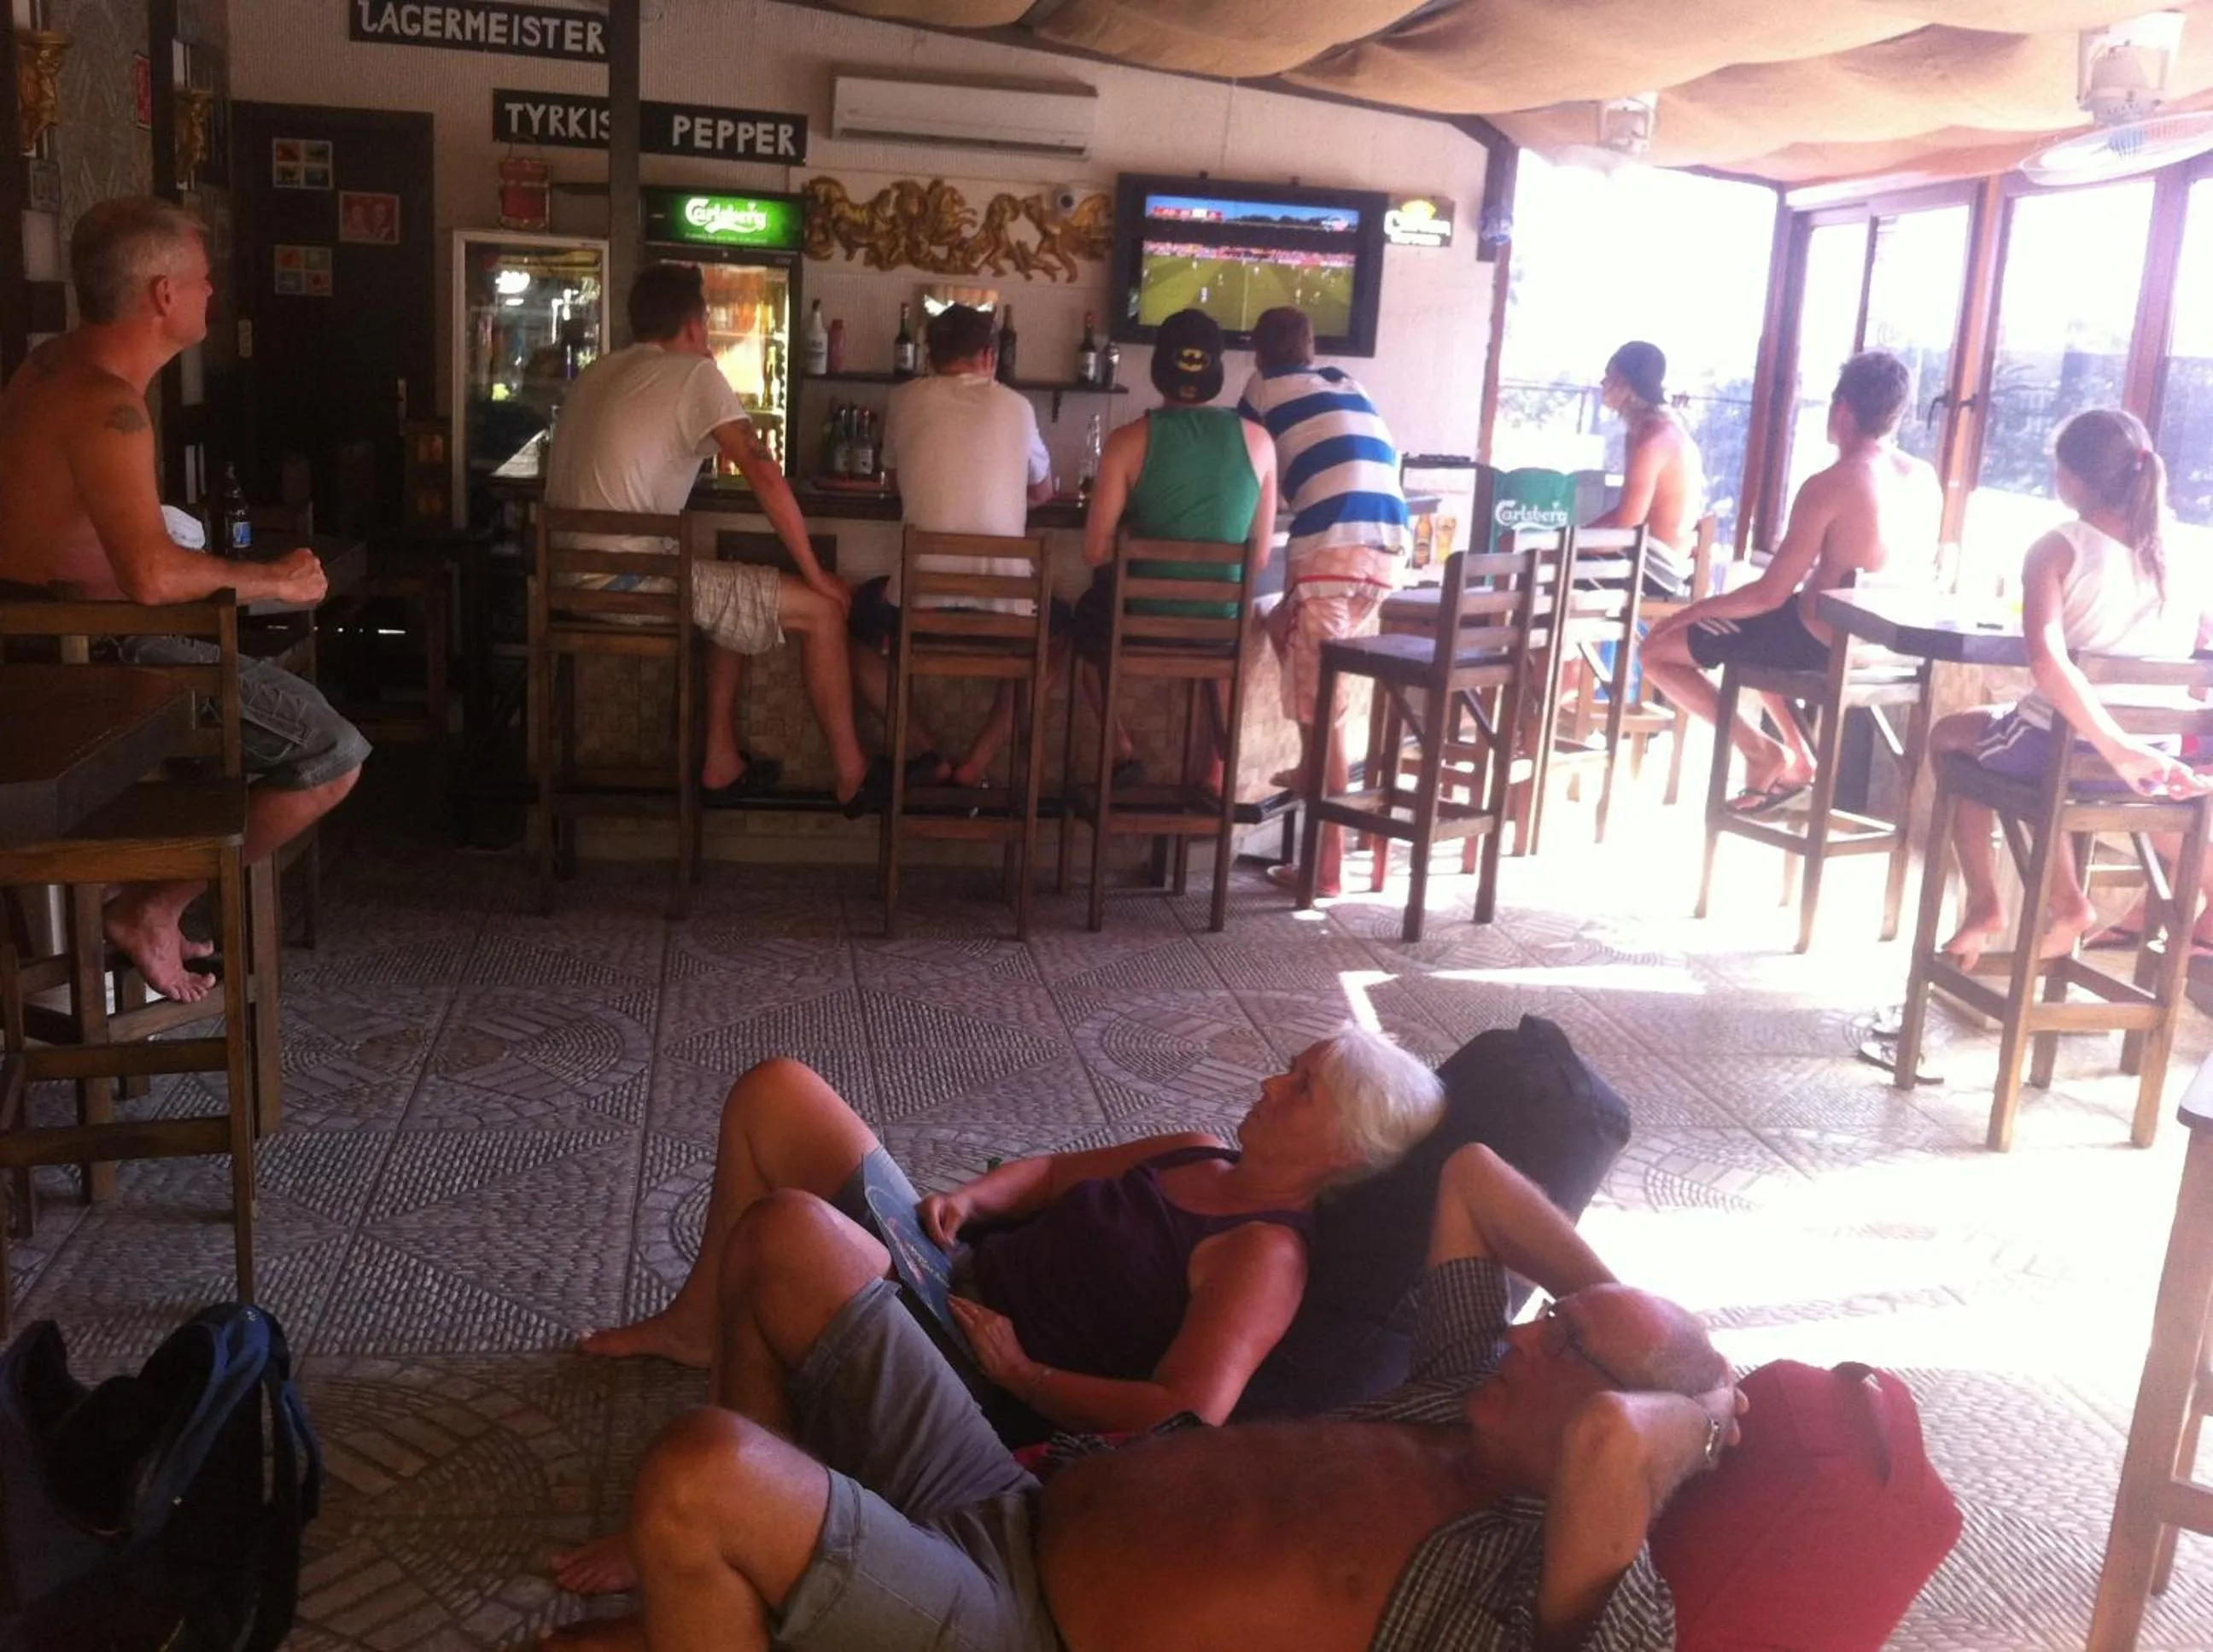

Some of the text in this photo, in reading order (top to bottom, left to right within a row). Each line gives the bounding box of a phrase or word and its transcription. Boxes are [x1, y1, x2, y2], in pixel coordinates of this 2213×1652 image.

[504, 102, 796, 157] TYRKIS PEPPER
[1495, 499, 1568, 530] Carlsberg
